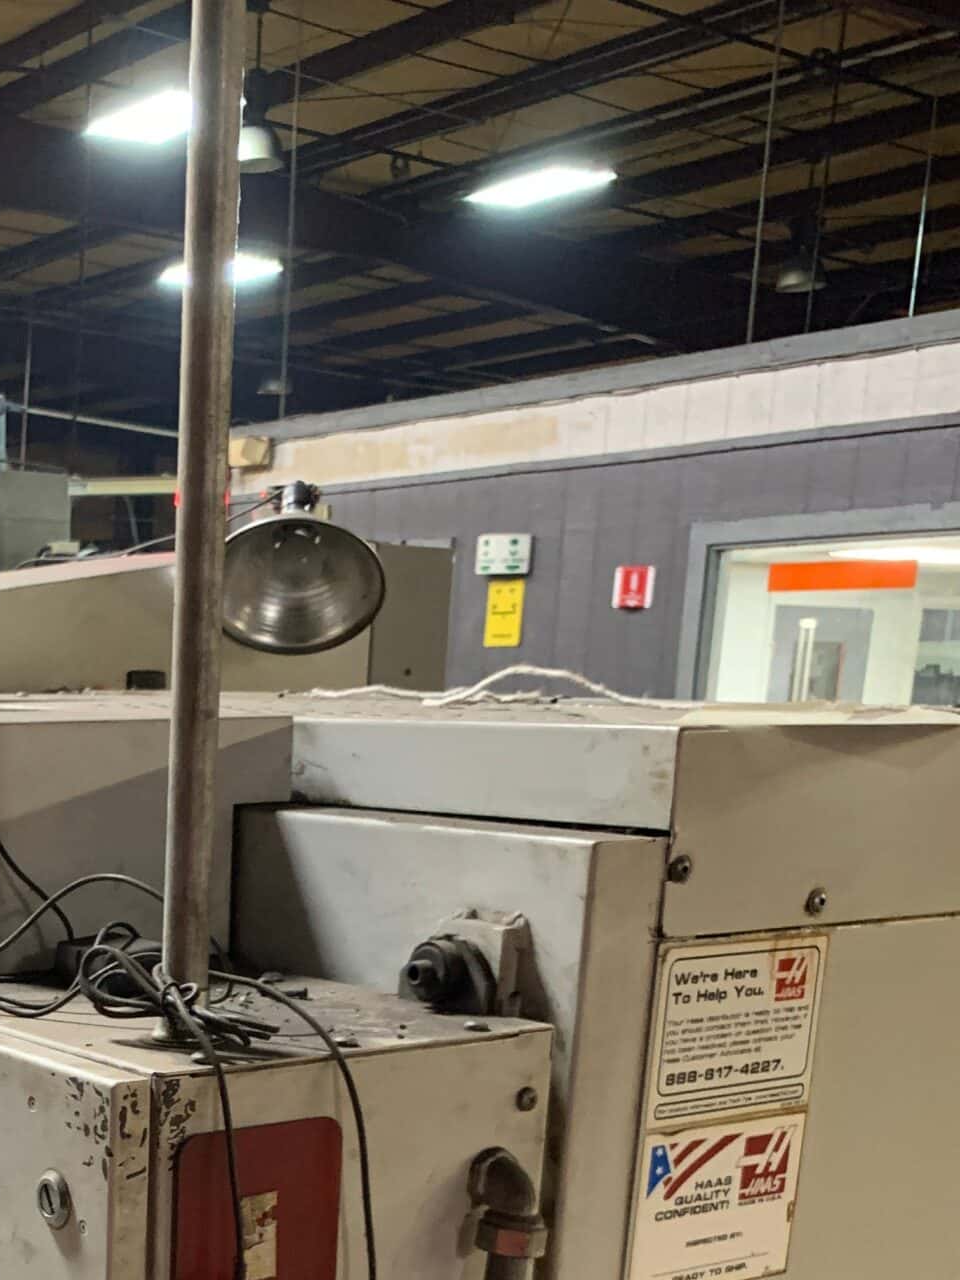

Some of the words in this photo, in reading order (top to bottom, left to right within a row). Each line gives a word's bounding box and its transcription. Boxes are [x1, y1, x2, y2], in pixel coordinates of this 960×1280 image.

[674, 970, 719, 986] We're
[724, 967, 758, 981] Here
[672, 992, 690, 1005] To
[696, 988, 728, 1003] Help
[734, 985, 764, 998] You.
[695, 1175, 732, 1191] HAAS
[674, 1187, 731, 1206] QUALITY
[709, 1266, 722, 1276] TO
